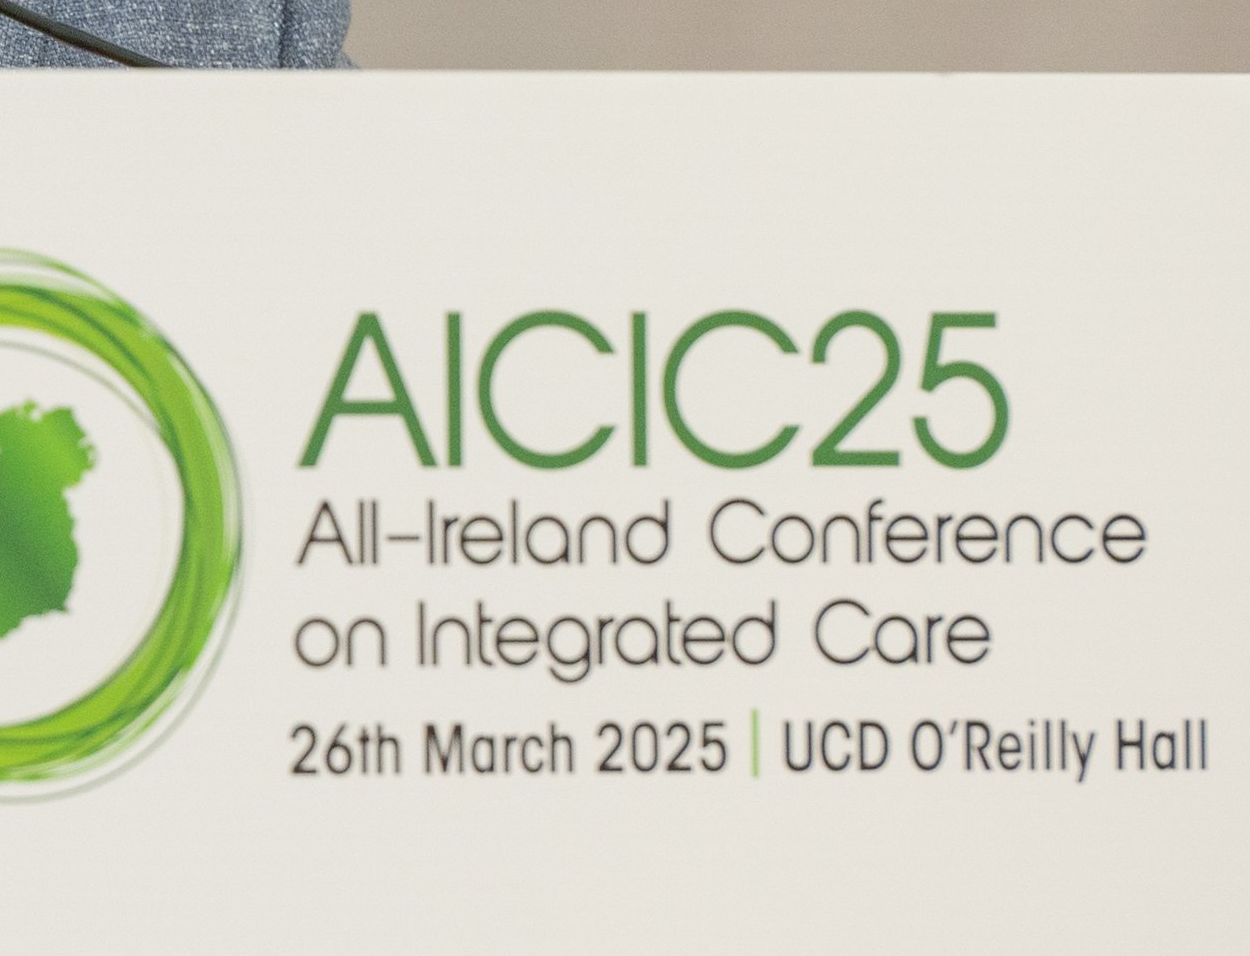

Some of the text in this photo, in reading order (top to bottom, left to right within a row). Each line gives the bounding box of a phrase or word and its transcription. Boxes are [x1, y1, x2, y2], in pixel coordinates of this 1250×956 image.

[297, 309, 1010, 471] AICIC25
[296, 498, 1147, 566] All-Ireland Conference
[293, 598, 992, 685] on Integrated Care
[290, 719, 1207, 783] 26th March 2025 UCD O'Reilly Hall
